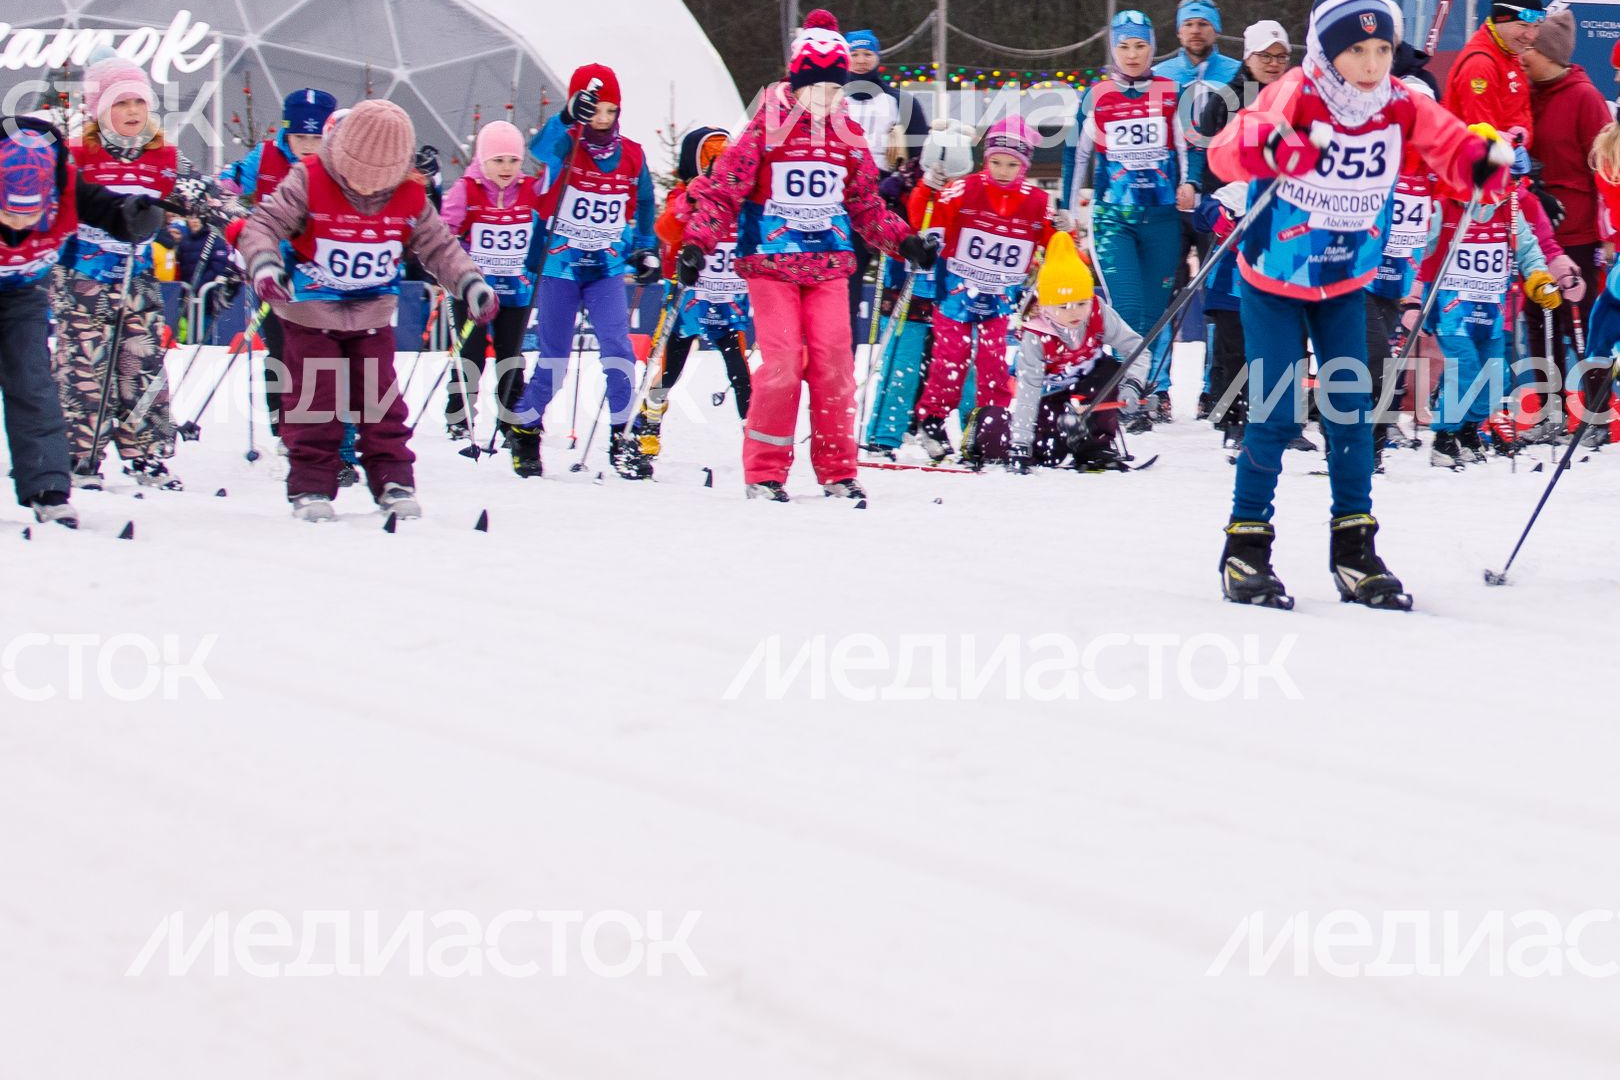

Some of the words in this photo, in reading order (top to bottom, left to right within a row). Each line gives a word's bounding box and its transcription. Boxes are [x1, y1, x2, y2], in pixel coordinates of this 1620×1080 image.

[1115, 122, 1158, 146] 288
[1316, 140, 1386, 180] 653
[572, 197, 622, 224] 659
[1323, 216, 1365, 228] ЛЫЖНЯ
[1391, 199, 1424, 226] 34
[480, 229, 528, 250] 633
[968, 236, 1021, 268] 648
[328, 249, 393, 279] 669
[1457, 249, 1504, 273] 668
